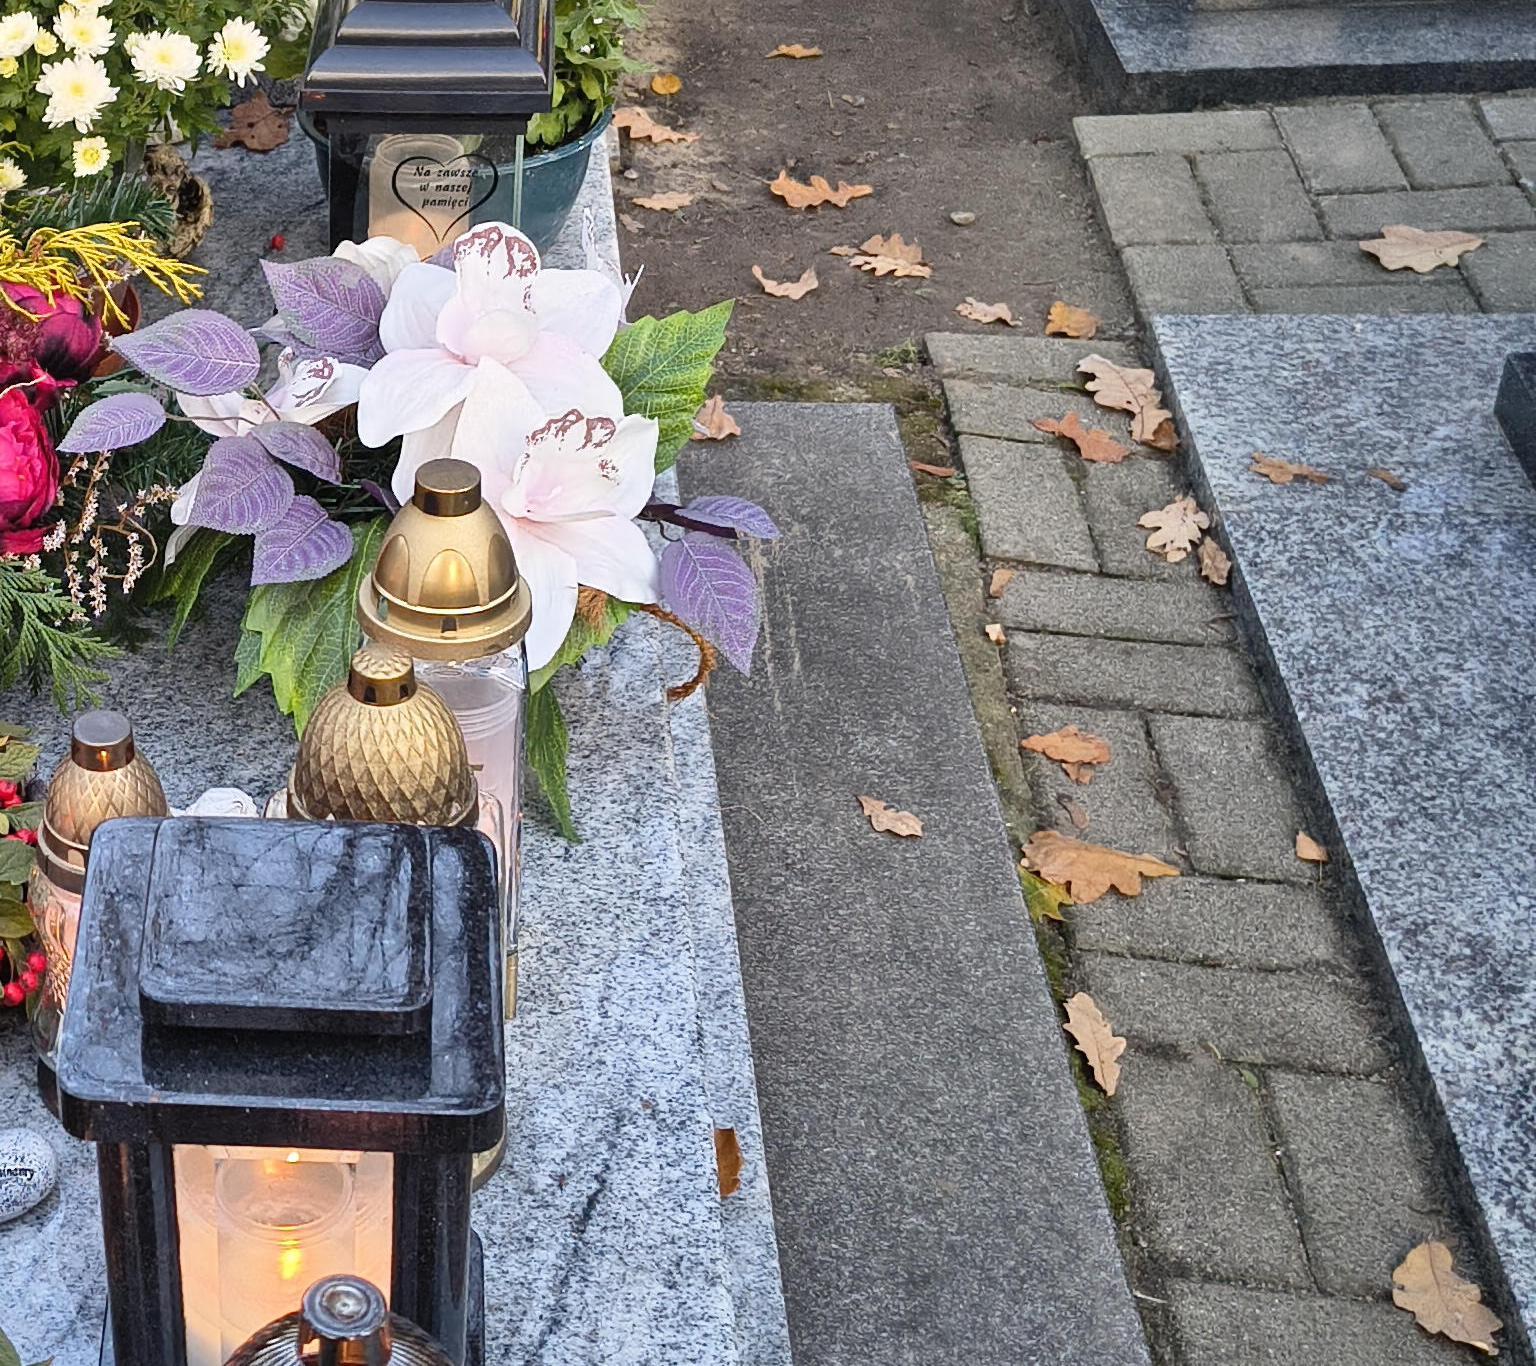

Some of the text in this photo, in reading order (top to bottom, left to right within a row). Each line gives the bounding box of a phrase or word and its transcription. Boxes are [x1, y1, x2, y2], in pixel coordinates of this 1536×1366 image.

[413, 166, 478, 178] Na zawsze
[419, 181, 473, 195] w naszej
[421, 197, 470, 210] pamięci
